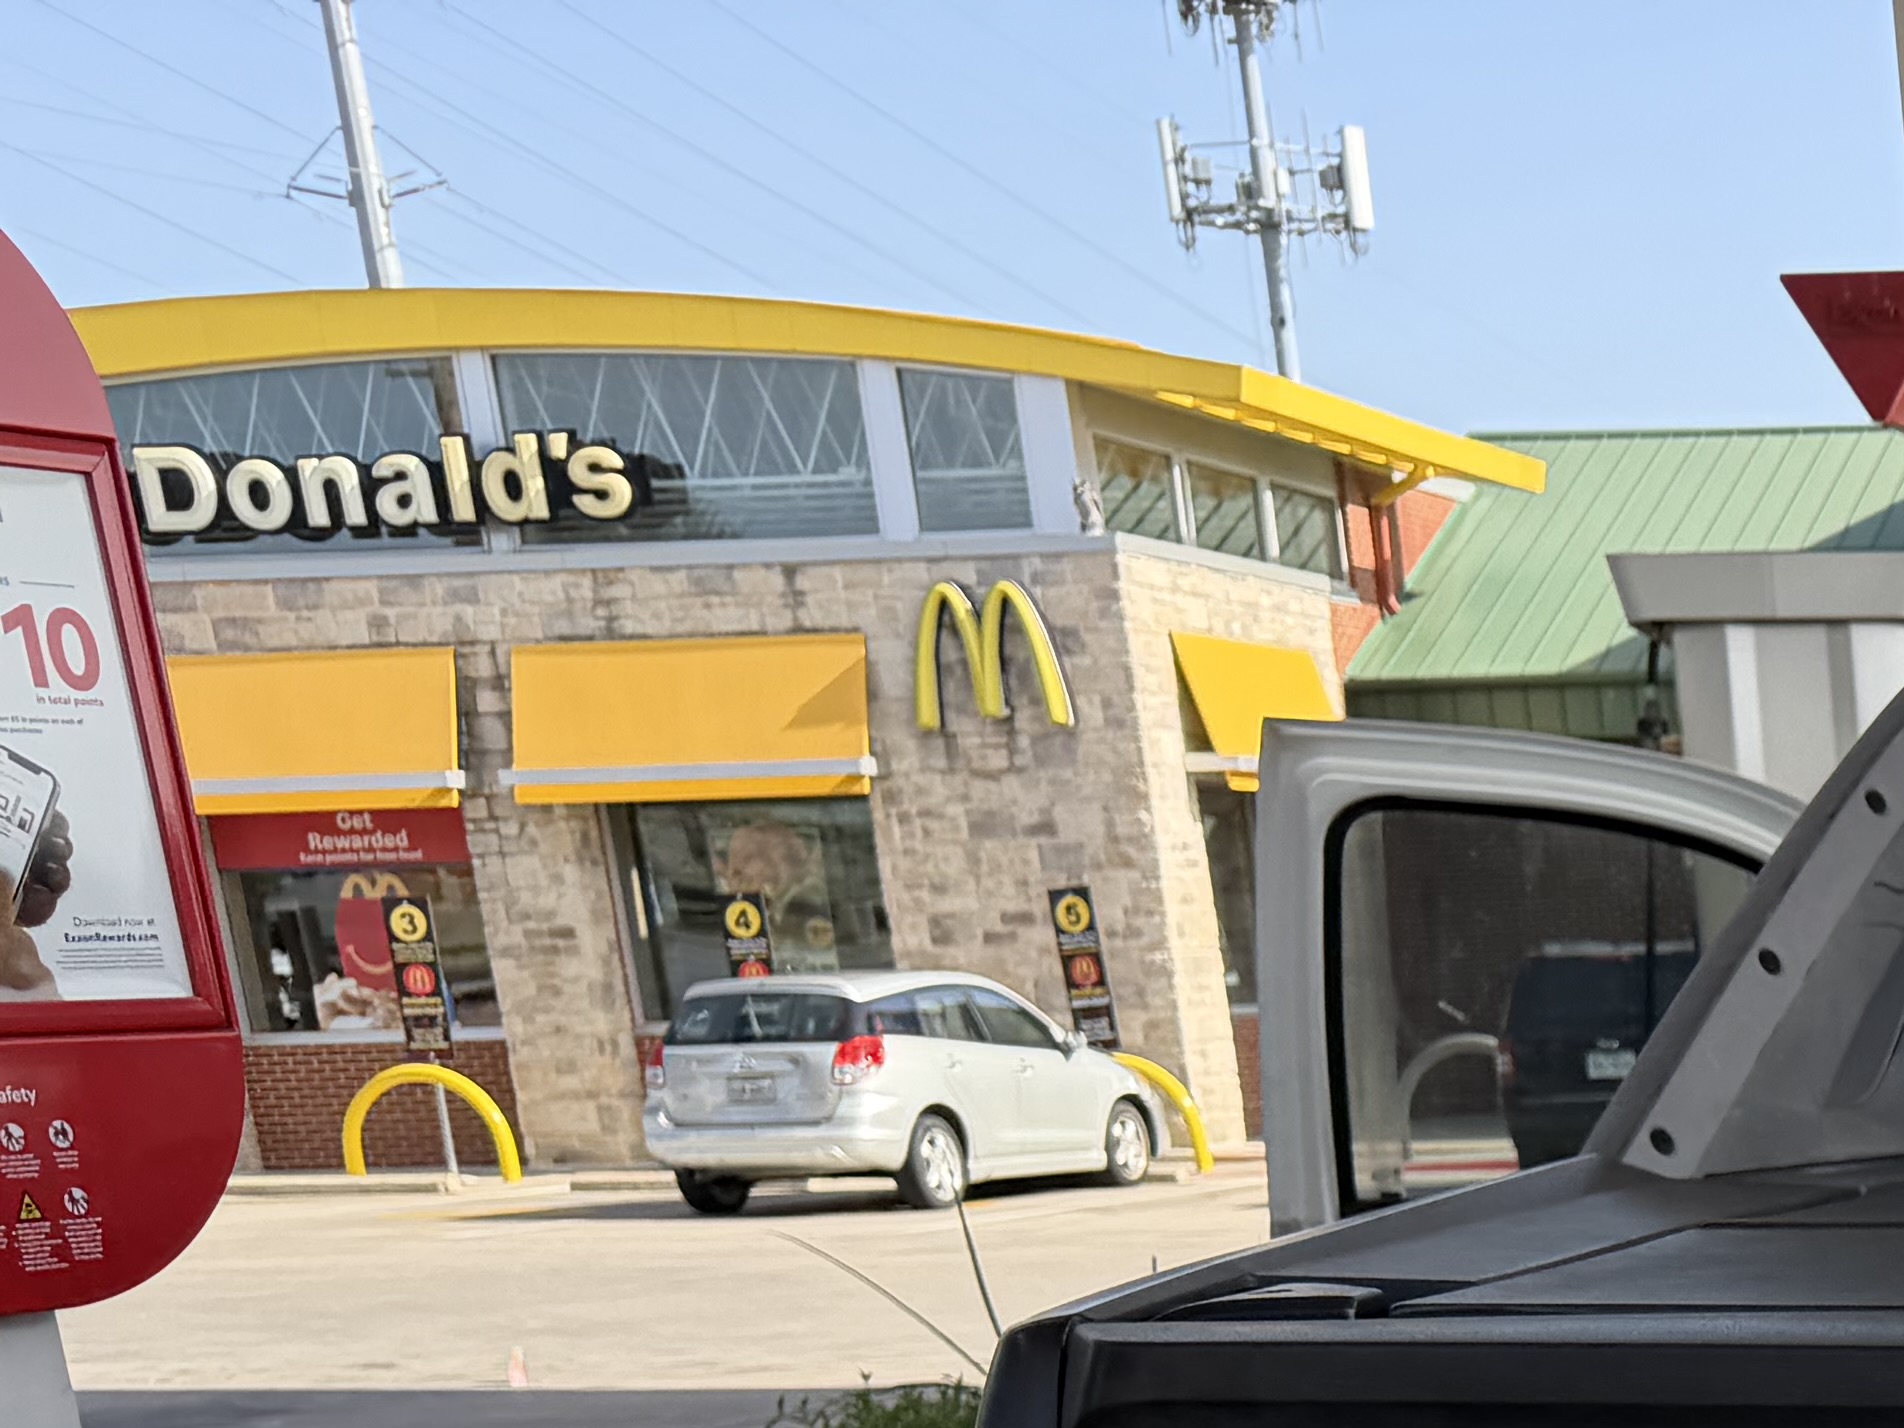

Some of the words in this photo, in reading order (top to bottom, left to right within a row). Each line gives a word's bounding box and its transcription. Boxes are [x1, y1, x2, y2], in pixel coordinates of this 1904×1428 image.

[132, 433, 634, 533] Donald's
[336, 811, 374, 830] Get
[308, 828, 409, 850] Rewarded
[400, 912, 418, 935] 3
[734, 908, 752, 931] 4
